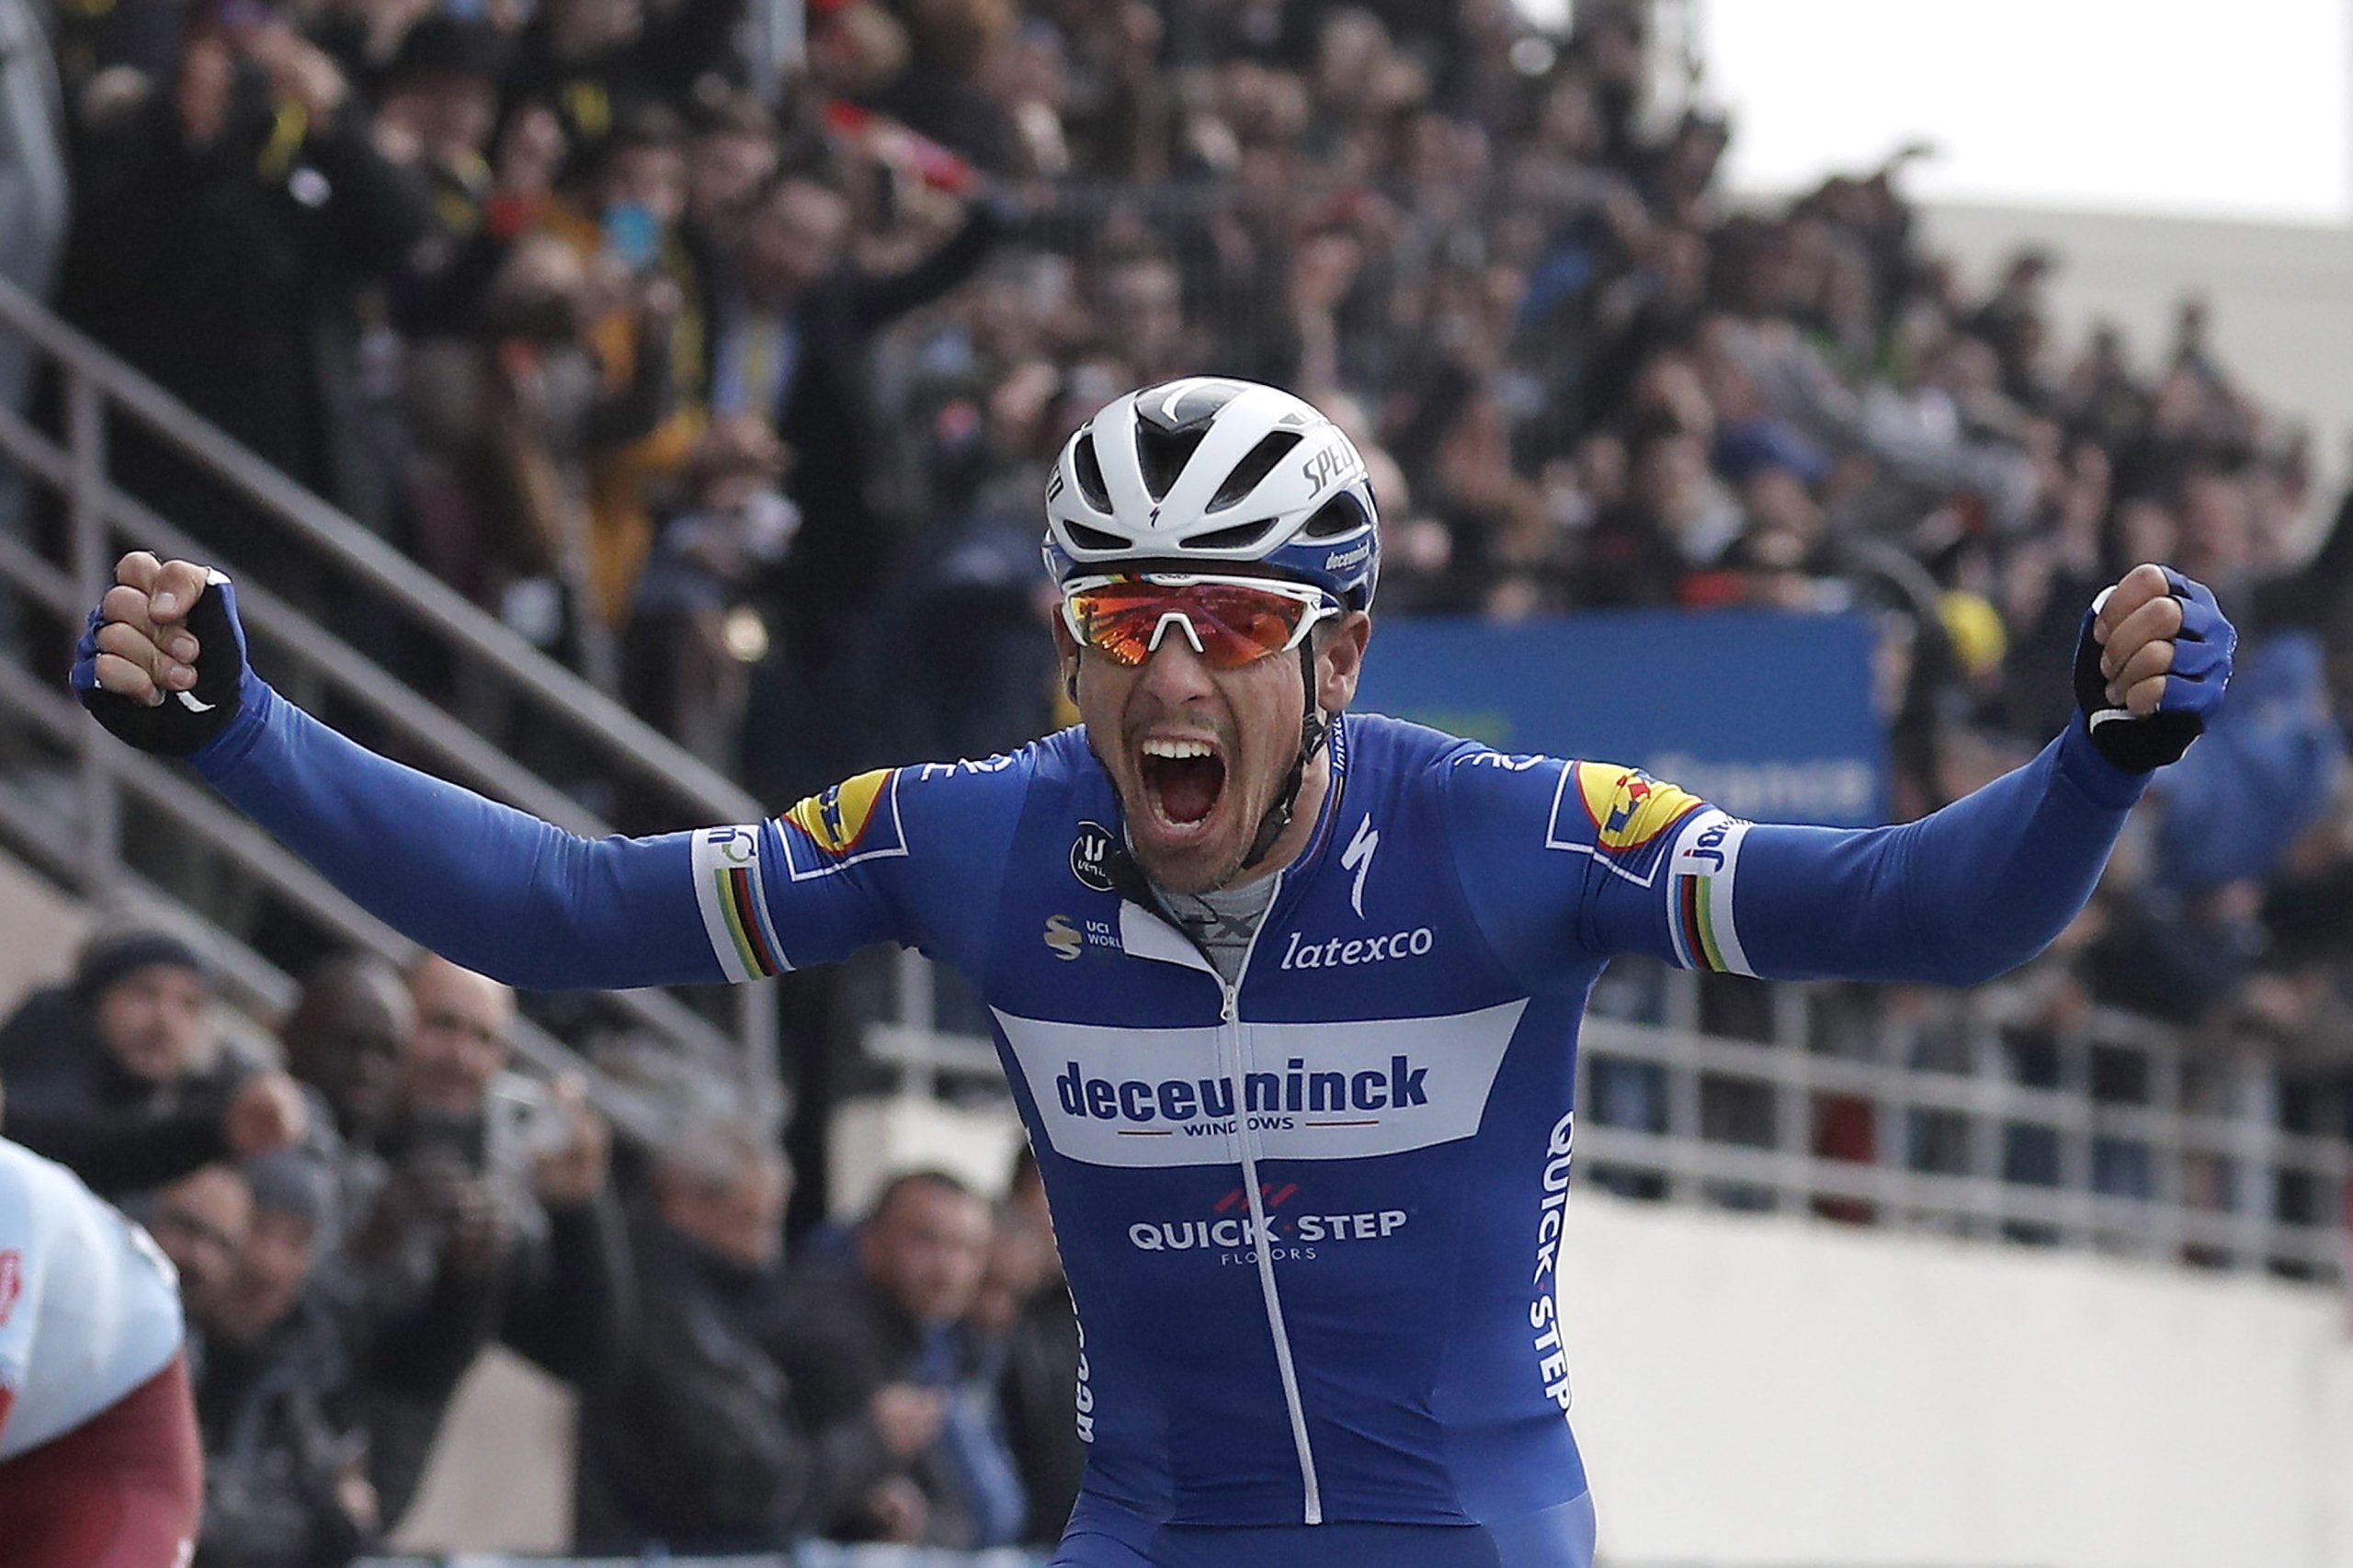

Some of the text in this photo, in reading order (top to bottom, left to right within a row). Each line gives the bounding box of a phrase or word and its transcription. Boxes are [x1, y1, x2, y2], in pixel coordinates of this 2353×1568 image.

[1086, 920, 1109, 934] UCI
[1280, 927, 1433, 970] latexco
[1056, 1055, 1429, 1122] deceuninck
[1184, 1116, 1294, 1137] WINDOWS
[1128, 1210, 1408, 1251] QUICK STEP
[1221, 1247, 1317, 1267] FLOORS
[1529, 1111, 1574, 1412] QUICK STEP
